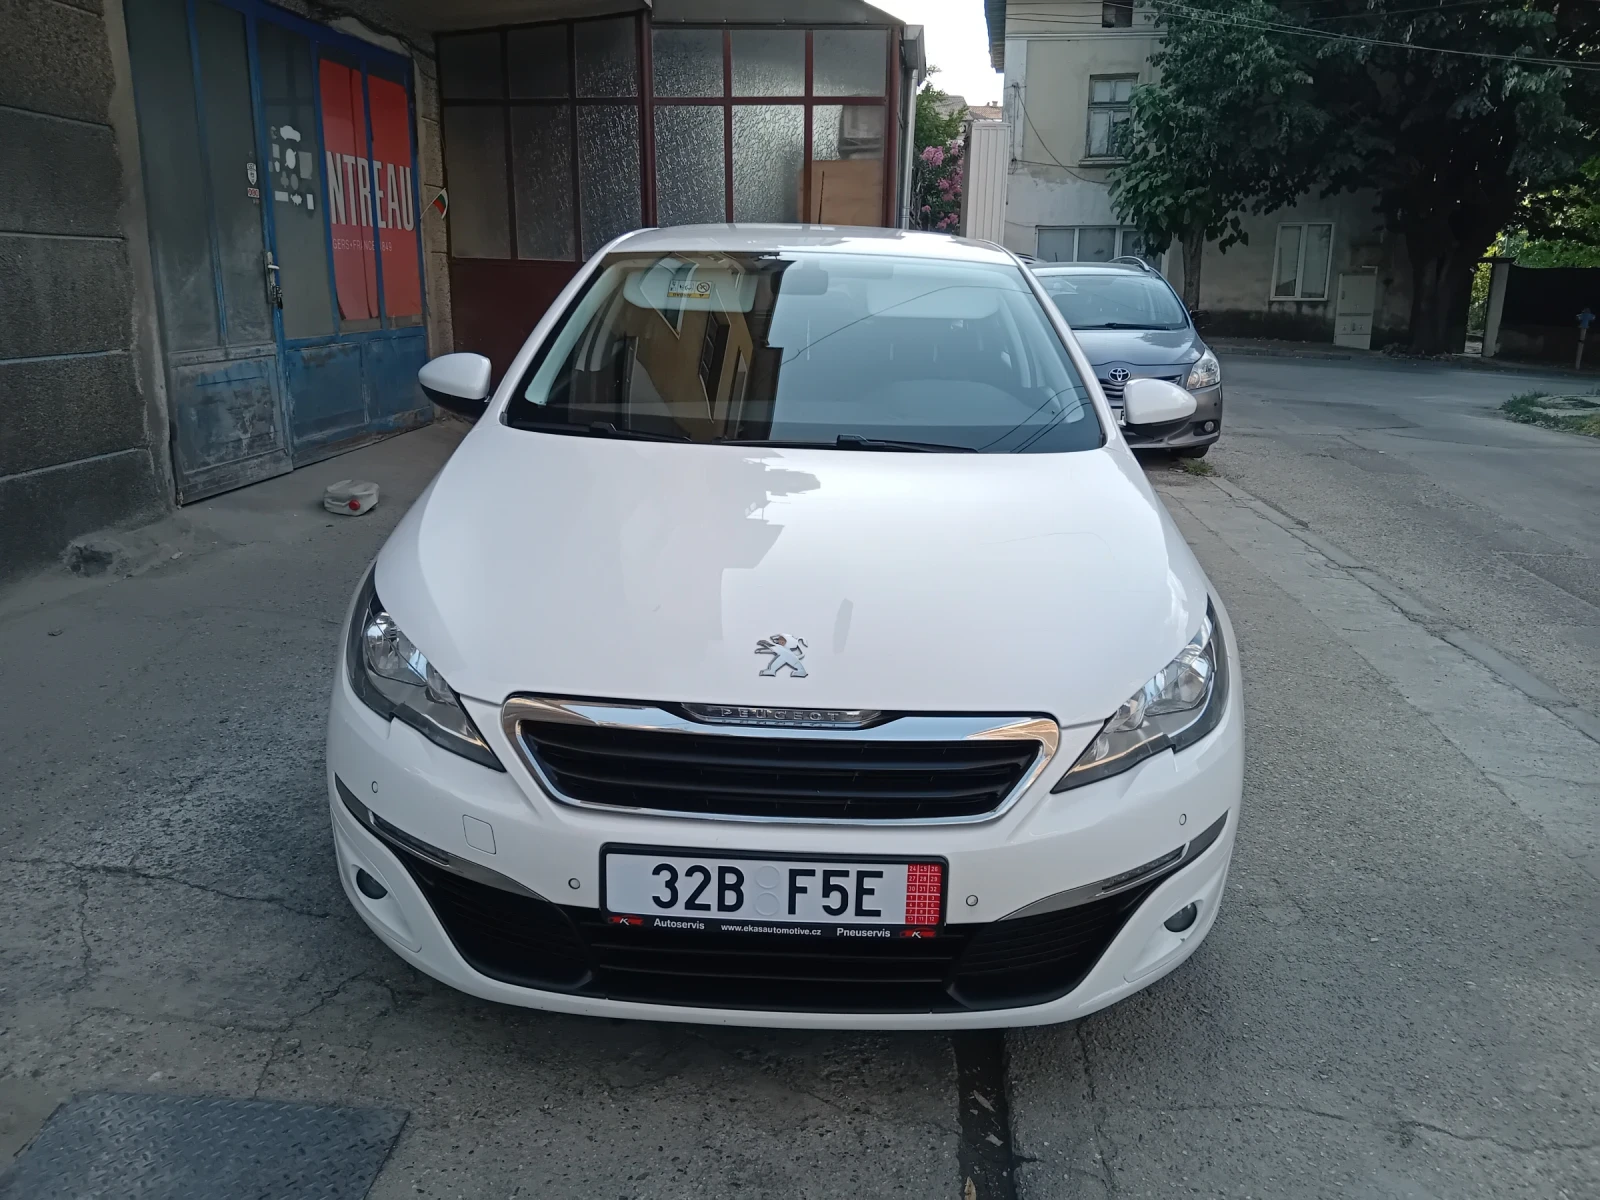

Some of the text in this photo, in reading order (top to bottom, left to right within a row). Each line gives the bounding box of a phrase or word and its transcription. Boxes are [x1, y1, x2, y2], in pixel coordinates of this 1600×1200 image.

[326, 151, 414, 231] NTREAU
[721, 707, 839, 721] PEUGEOT
[652, 863, 884, 917] 32B F5E
[653, 918, 891, 938] Autoservis www.ekasautomotive.cz Pneuservis
